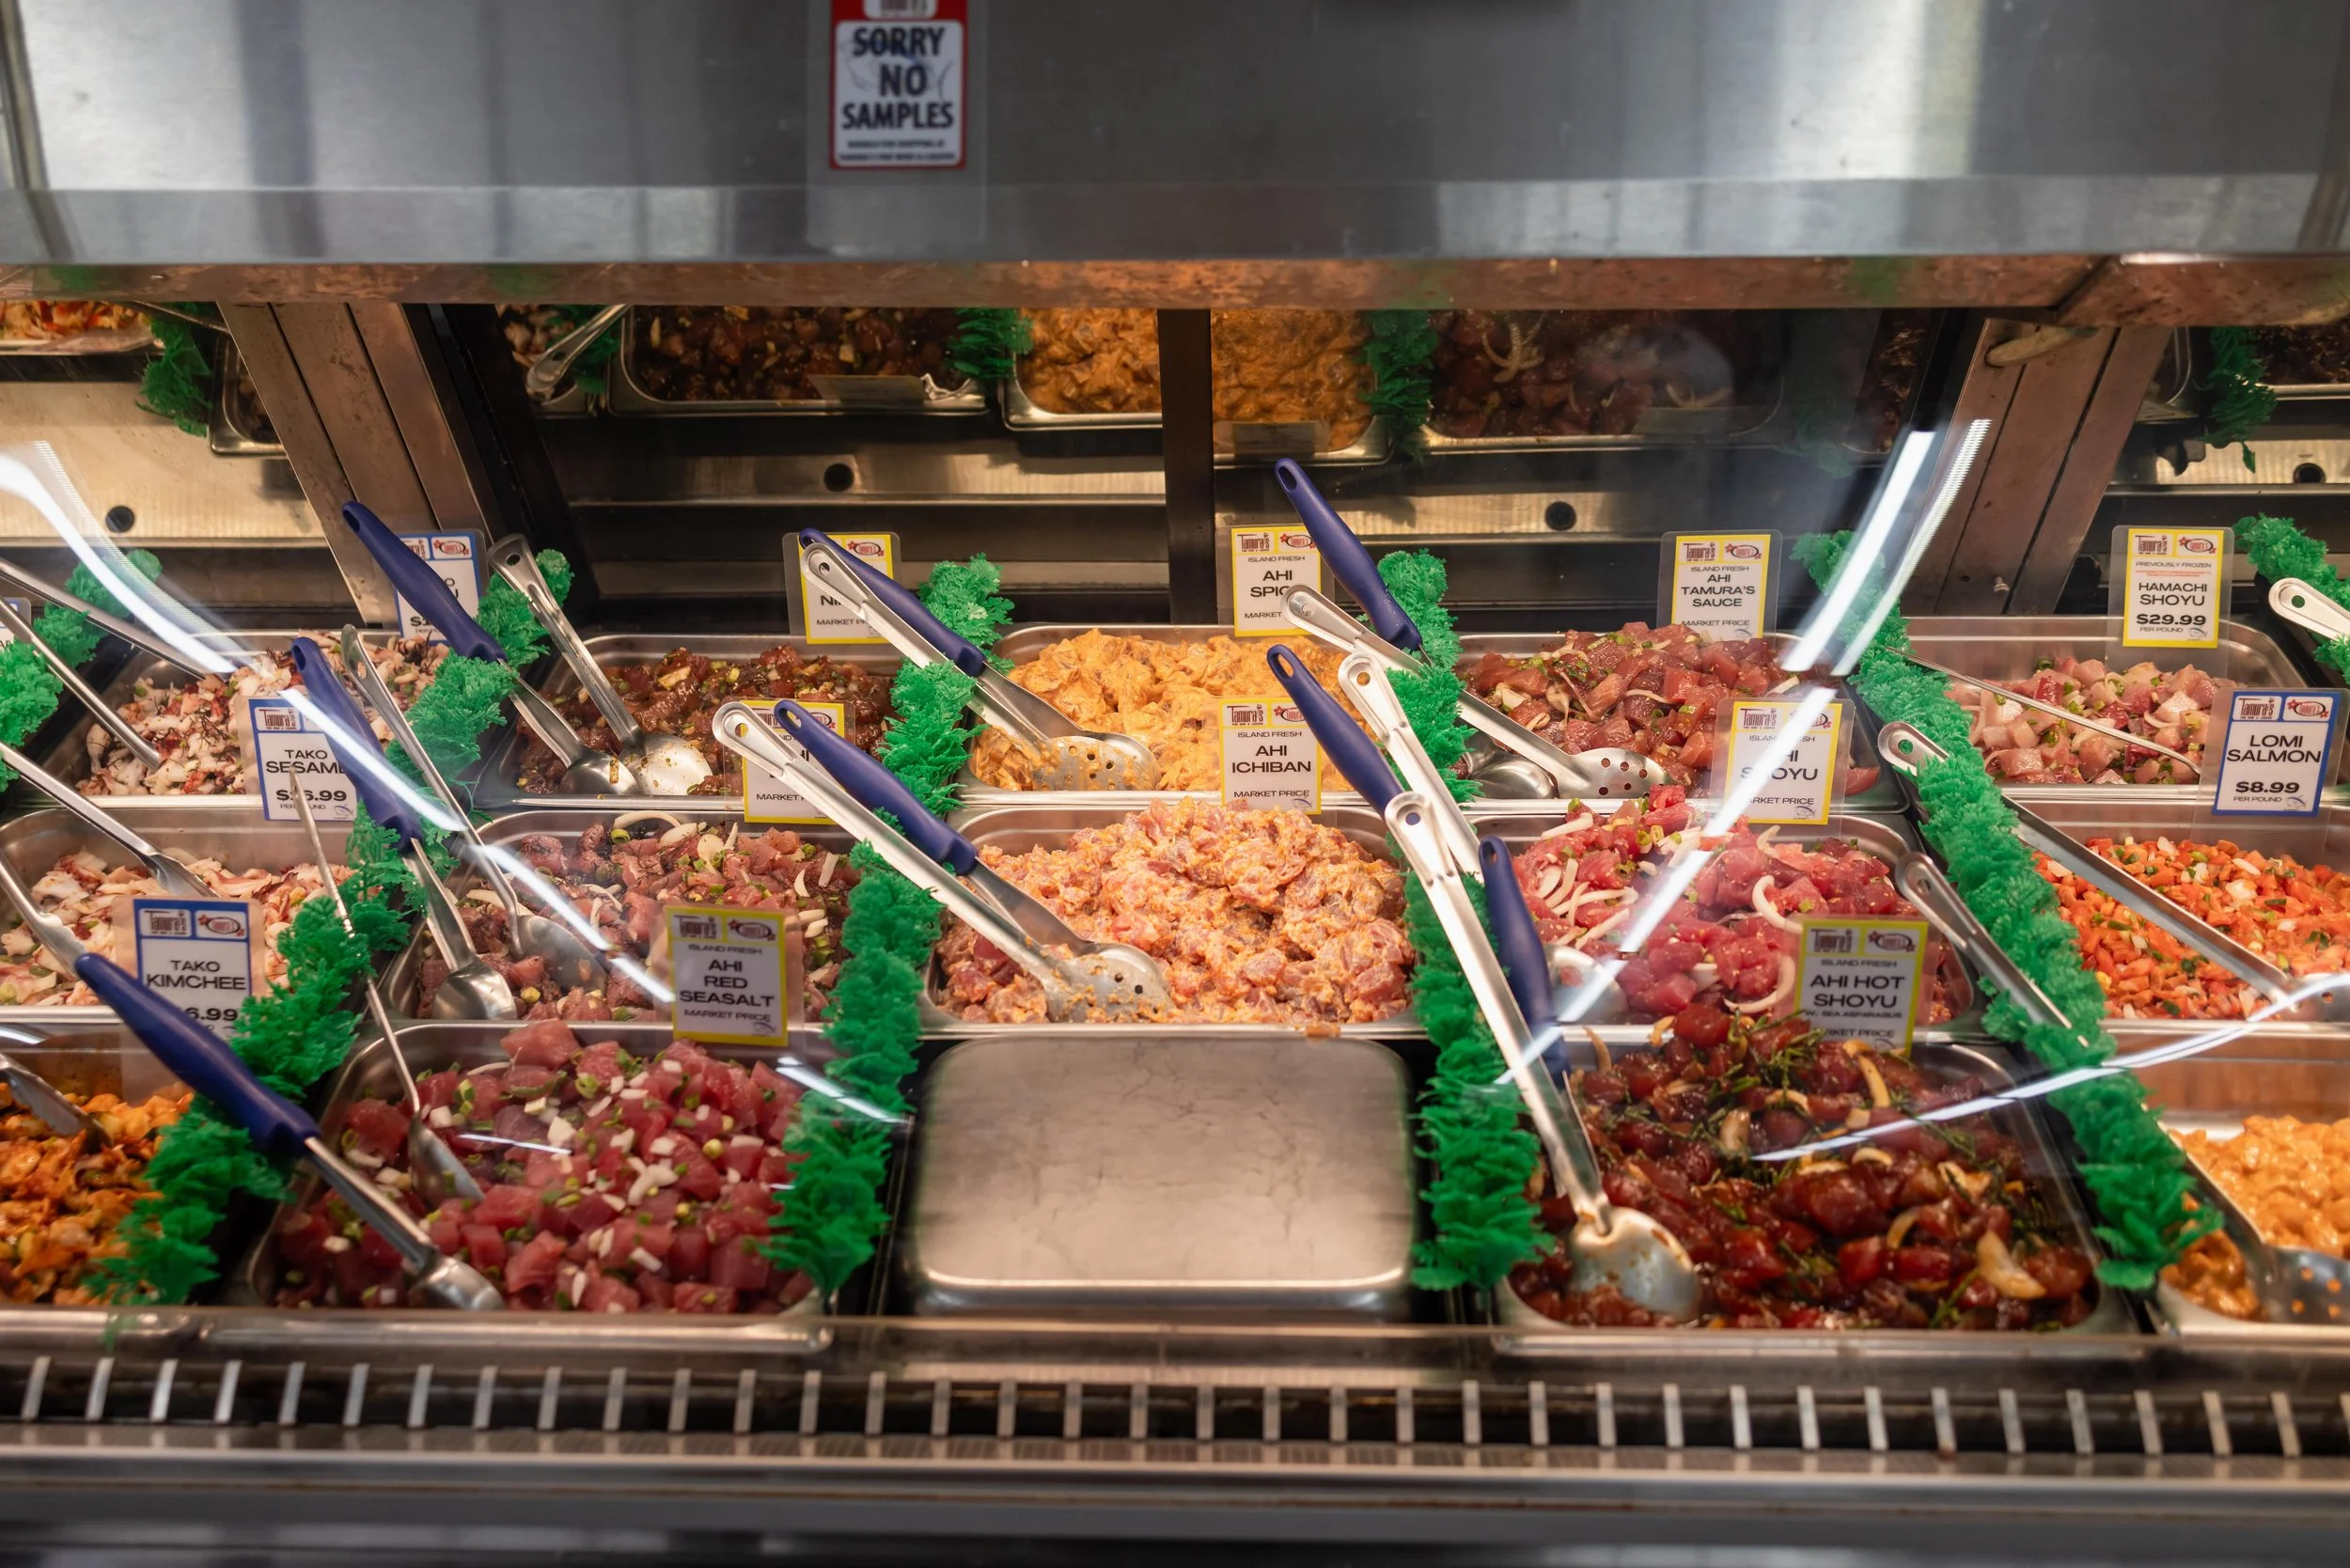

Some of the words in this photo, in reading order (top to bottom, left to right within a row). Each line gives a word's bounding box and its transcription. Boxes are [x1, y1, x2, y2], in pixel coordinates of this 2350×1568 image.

[852, 26, 946, 57] SORRY
[879, 63, 928, 97] NO
[841, 102, 954, 130] SAMPLES
[1262, 570, 1292, 581] AHI
[1707, 574, 1731, 583] AHI
[1250, 586, 1290, 598] SPIC
[1681, 586, 1755, 595] TAMURA'S
[2138, 582, 2207, 592] HAMACHI
[1692, 598, 1743, 607] SAUCE
[2139, 594, 2205, 606] SHOYU
[2136, 613, 2207, 626] $29.99
[2249, 734, 2304, 747] LOMI
[284, 749, 328, 760] TAKO
[1255, 745, 1288, 756] AHI
[2226, 748, 2322, 762] SALMON
[1231, 761, 1311, 774] ICHIBAN
[1740, 766, 1819, 781] SOYU
[2234, 780, 2300, 794] $8.99
[170, 960, 221, 972] TAKO
[708, 959, 743, 972] AHI
[146, 974, 247, 991] KIMCHEE
[703, 976, 748, 989] RED
[1810, 975, 1848, 988] AHI
[1854, 976, 1905, 990] HOT
[680, 990, 776, 1007] SEASALT
[1813, 994, 1897, 1009] SHOYU
[684, 1009, 733, 1019] MARKET
[735, 1012, 771, 1022] PRICE
[1857, 1028, 1895, 1038] PRICE
